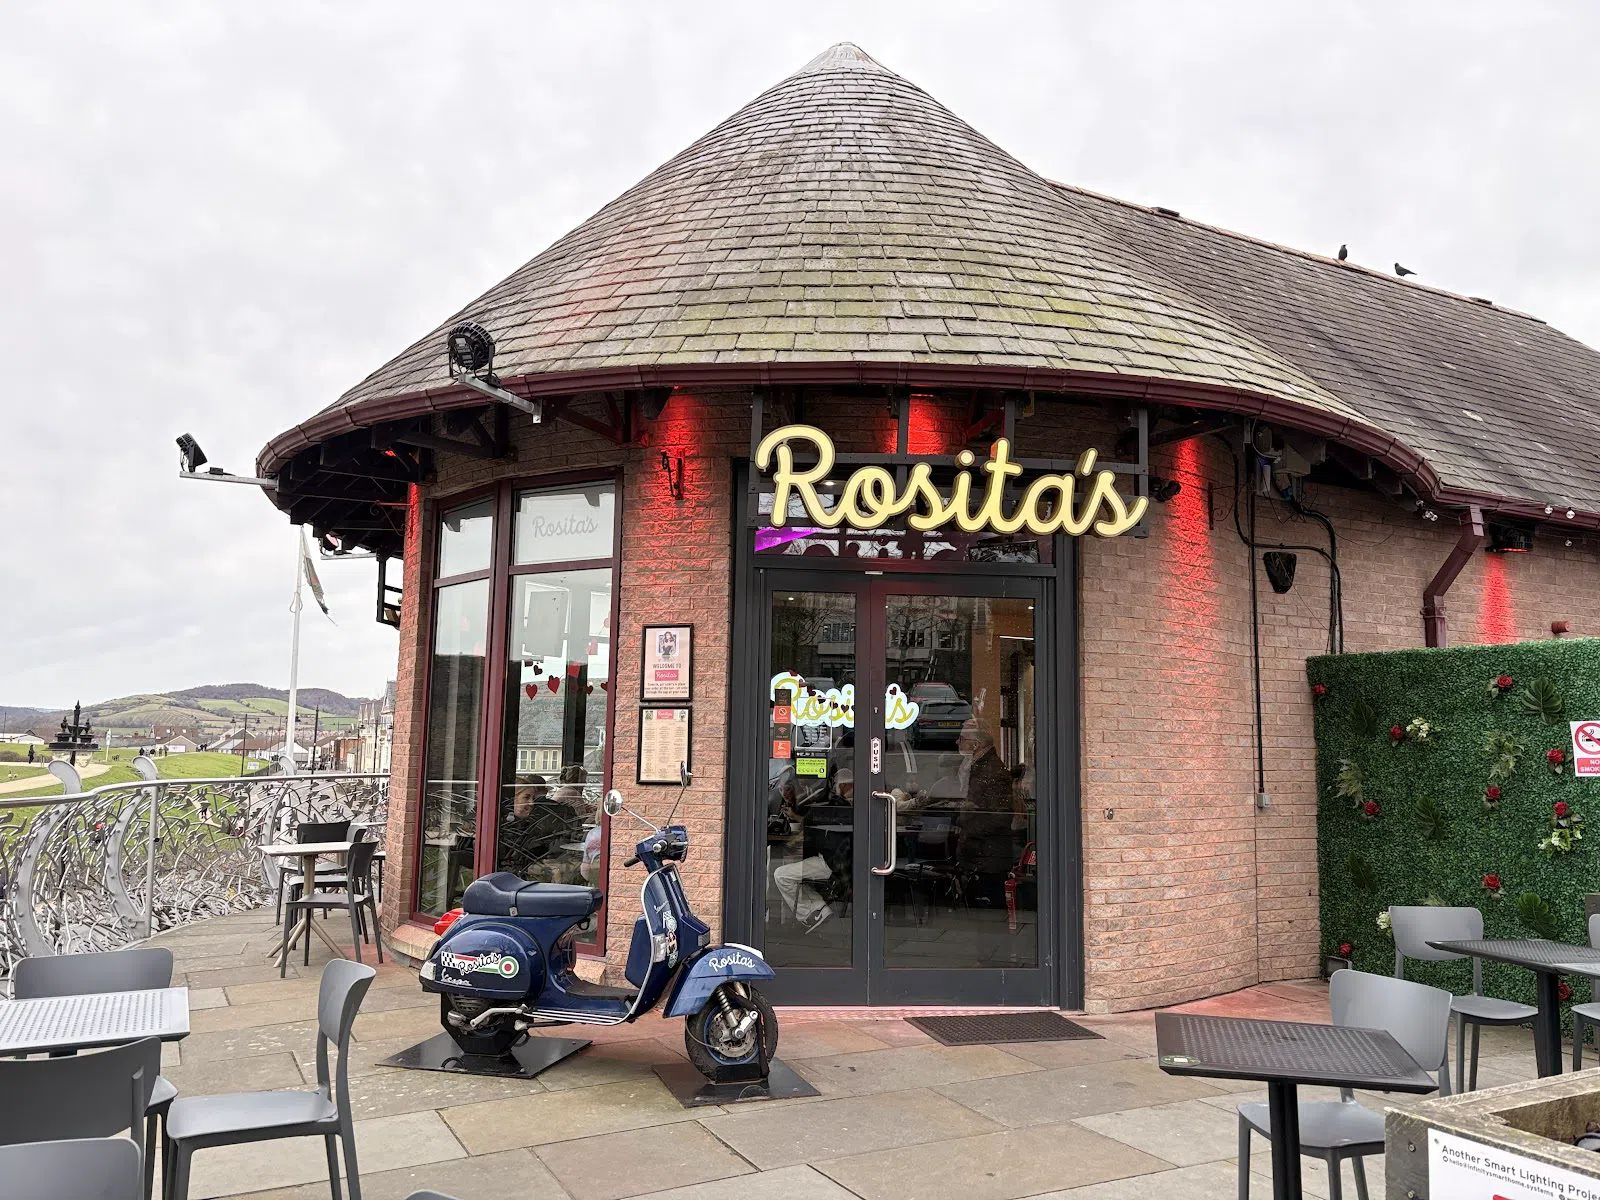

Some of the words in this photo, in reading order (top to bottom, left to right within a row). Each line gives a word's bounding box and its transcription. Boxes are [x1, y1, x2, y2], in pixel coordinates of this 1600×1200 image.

[755, 424, 1149, 538] Rosita's
[532, 514, 599, 538] Rosita's
[458, 952, 502, 975] Rosita's
[708, 951, 756, 973] Rosita's
[440, 968, 473, 987] Vespa
[1442, 1145, 1481, 1164] Another
[1484, 1158, 1516, 1176] Smart
[1519, 1169, 1564, 1193] Lighting
[1568, 1184, 1600, 1200] Proje
